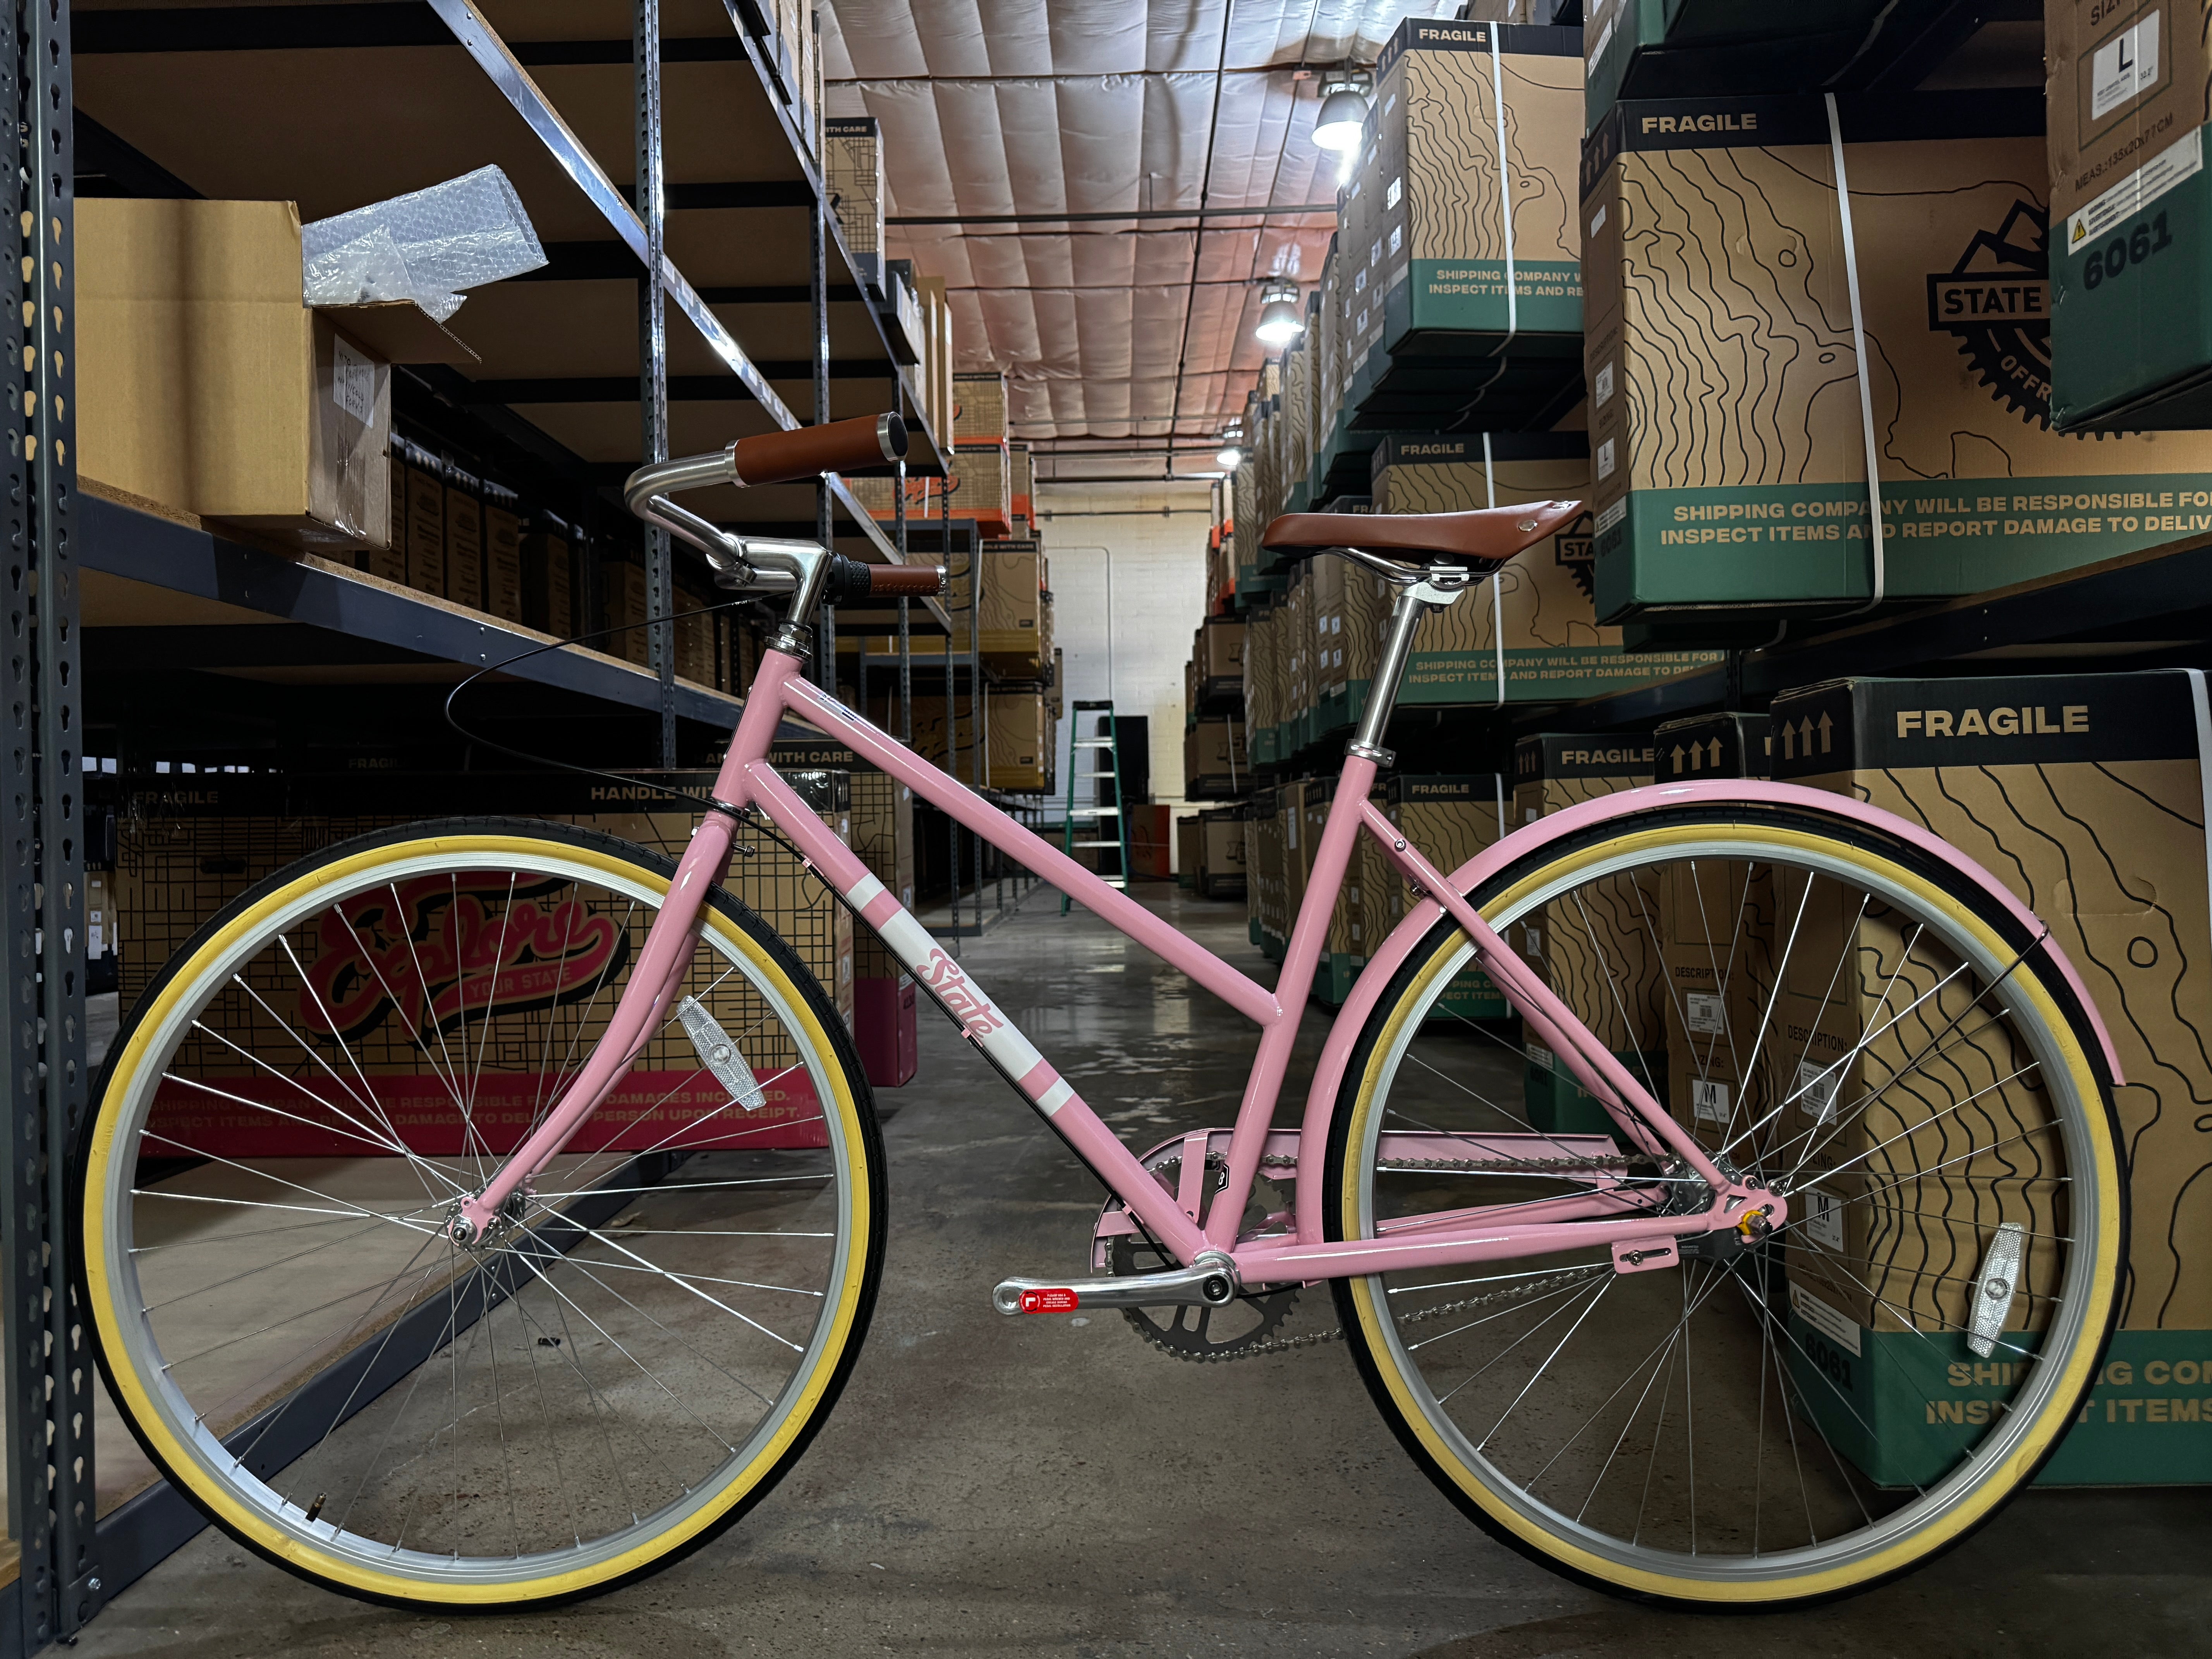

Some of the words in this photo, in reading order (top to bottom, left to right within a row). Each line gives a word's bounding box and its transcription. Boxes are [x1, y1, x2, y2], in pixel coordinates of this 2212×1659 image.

[1419, 28, 1486, 43] FRAGILE
[2119, 38, 2133, 72] L
[1642, 113, 1757, 134] FRAGILE
[2084, 209, 2172, 289] 6061
[1437, 270, 1501, 280] SHIPPING
[1429, 284, 1487, 294] INSPECT
[1535, 286, 1563, 296] AND
[1944, 287, 2042, 314] STATE
[2001, 356, 2051, 401] OFFR
[1400, 443, 1464, 456] FRAGILE
[1604, 445, 1608, 461] L
[1674, 503, 1784, 522] SHIPPING
[1915, 498, 1970, 514] WILL
[1977, 497, 2006, 513] BE
[2013, 493, 2173, 512] RESPONSIBLE
[2179, 491, 2212, 507] FO
[1661, 527, 1762, 544] INSPECT
[1769, 525, 1840, 542] ITEMS
[1902, 520, 1997, 538] REPORT
[2004, 518, 2101, 535] DAMAGE
[2107, 517, 2138, 532] TO
[1416, 659, 1476, 670] SHIPPING
[1547, 657, 1578, 666] WILL
[1581, 656, 1597, 665] BE
[1601, 653, 1689, 664] RESPONSIBLE
[1692, 653, 1717, 662] FOR
[1408, 673, 1464, 683] INSPECT
[1467, 672, 1506, 682] ITEM
[1510, 670, 1537, 680] AND
[1540, 668, 1592, 679] REPORT
[1596, 667, 1650, 677] DAMAGE
[1654, 666, 1670, 676] TO
[1896, 704, 2089, 738] FRAGILE
[809, 751, 853, 763] CARE
[1561, 749, 1654, 764] FRAGILE
[133, 791, 218, 805] FRAGILE
[591, 787, 675, 801] HANDLE
[1412, 784, 1469, 794] FRAGILE
[470, 977, 514, 998] YOUR
[522, 966, 571, 989] STATE
[1452, 980, 1481, 988] PING
[1675, 966, 1733, 981] DESCRIPTION:
[916, 948, 1004, 1038] State
[1788, 1025, 1847, 1053] DESCRIPTION:
[151, 1099, 229, 1111] SHIPPING
[401, 1096, 522, 1108] RESPONSIBLE
[607, 1091, 691, 1105] DAMAGES
[696, 1090, 790, 1103] INCED.
[1705, 1084, 1716, 1104] M
[145, 1115, 218, 1128] NSPECT
[220, 1115, 273, 1128] ITEMS
[474, 1112, 497, 1125] TO
[594, 1107, 664, 1121] PERSON
[723, 1107, 800, 1119] RECEIPT.
[1817, 1192, 1829, 1222] M
[1805, 1333, 1853, 1392] 6061
[2144, 1361, 2212, 1384] CO
